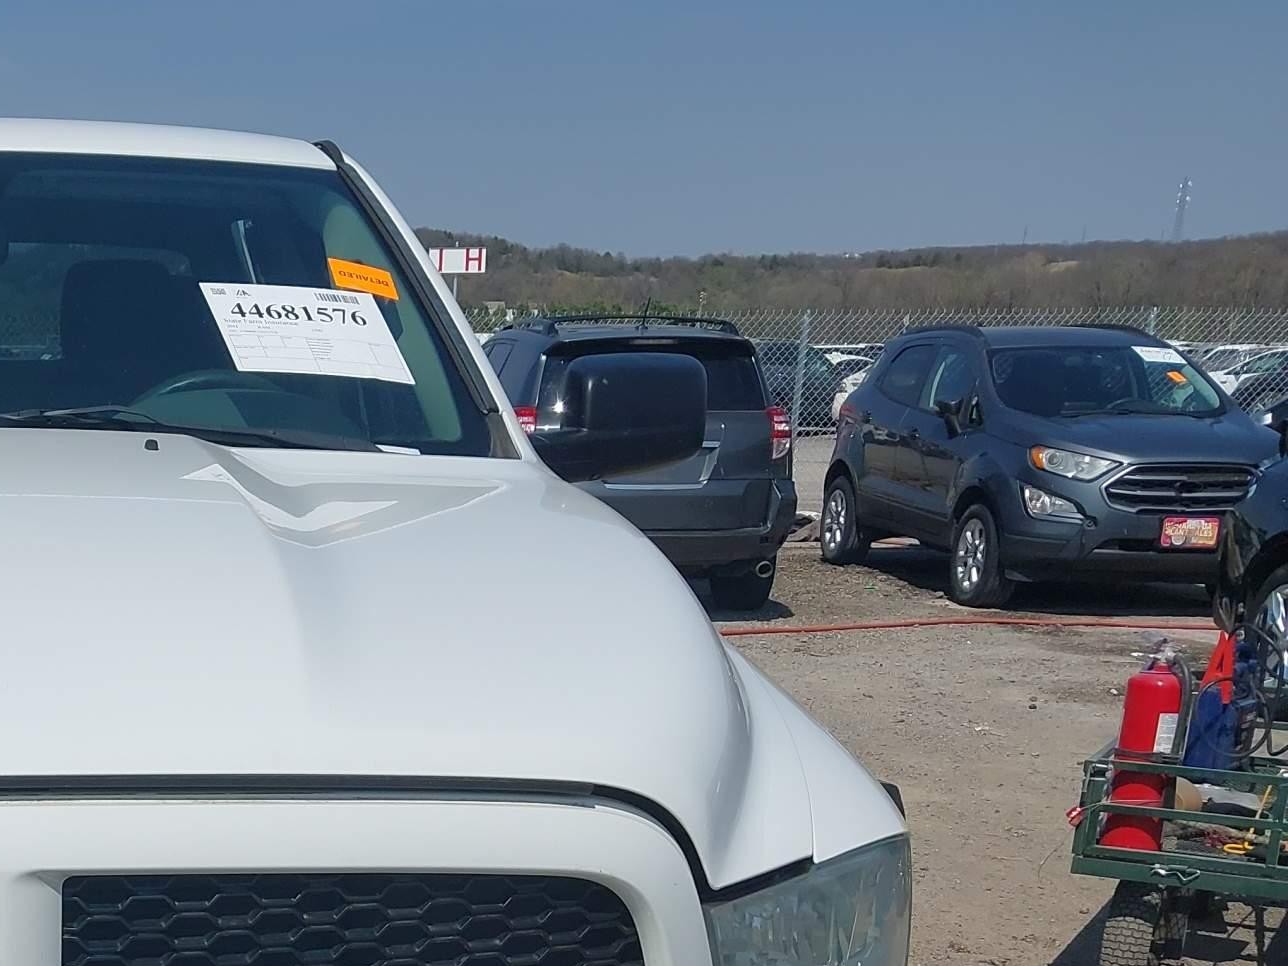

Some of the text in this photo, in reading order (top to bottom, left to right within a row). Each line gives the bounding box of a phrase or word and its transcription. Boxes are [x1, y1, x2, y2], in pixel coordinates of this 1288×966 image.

[465, 247, 483, 272] H
[338, 270, 390, 287] DETAILED
[230, 302, 368, 326] 44681576
